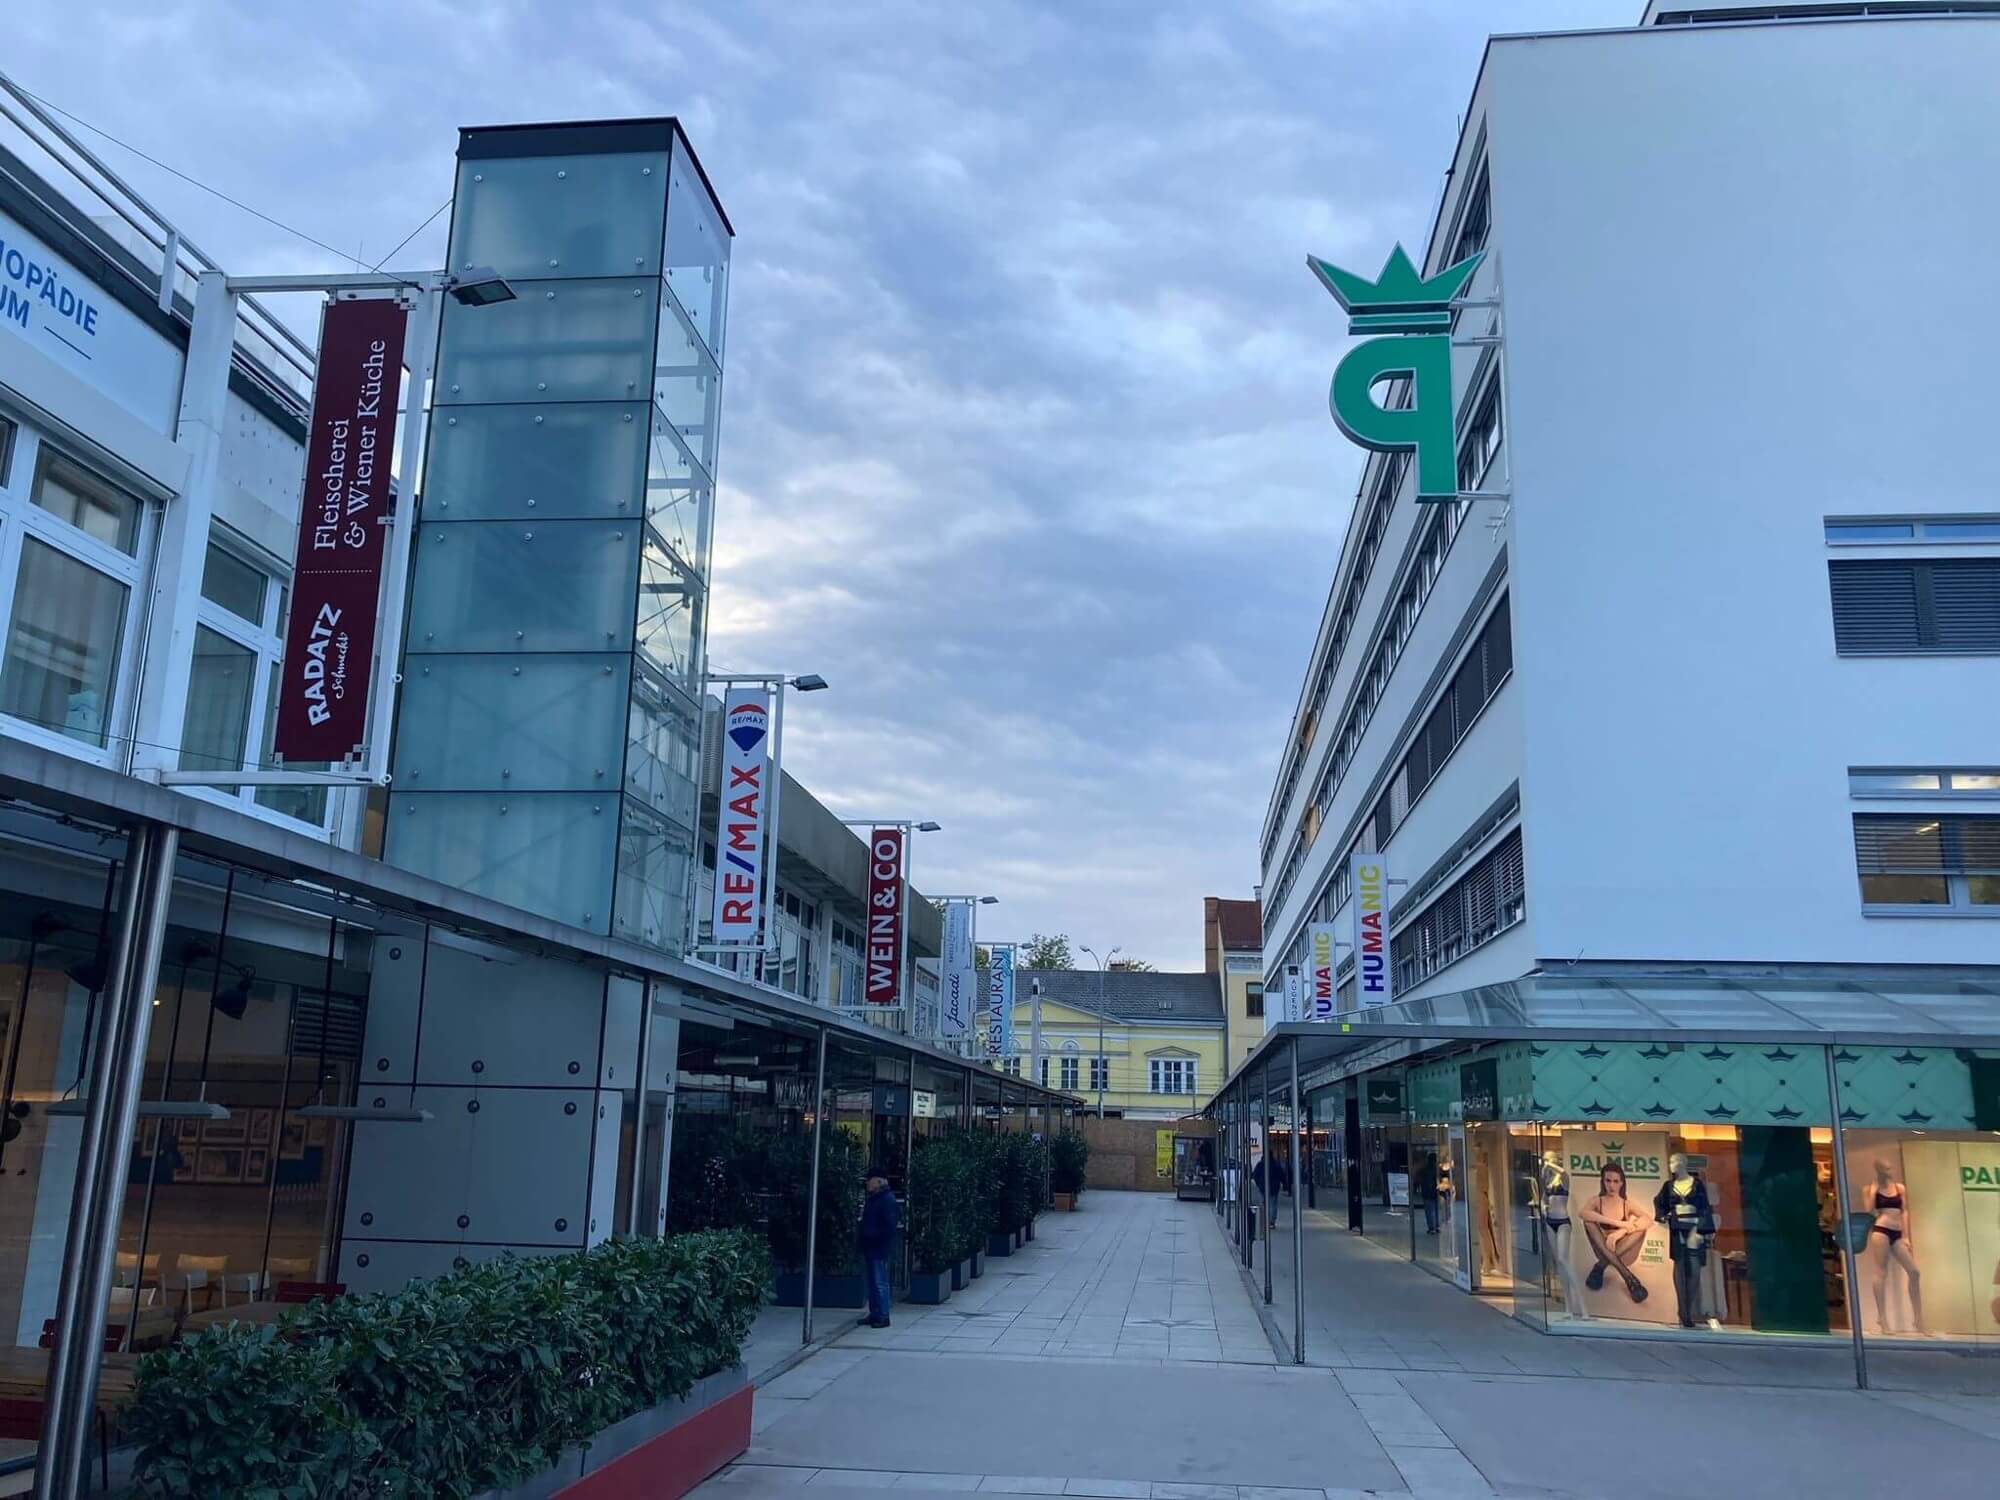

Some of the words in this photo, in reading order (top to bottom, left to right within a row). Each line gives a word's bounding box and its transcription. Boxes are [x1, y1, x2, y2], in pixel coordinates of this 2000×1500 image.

[0, 240, 98, 336] OPÄDIE
[357, 340, 386, 419] Küche
[314, 418, 350, 550] Fleischerei
[346, 425, 377, 515] Wiener
[343, 521, 366, 548] &
[303, 602, 342, 726] RADATZ
[731, 716, 765, 725] RE/MAX
[722, 764, 761, 924] RE/MAX
[873, 839, 897, 881] CO
[873, 886, 896, 909] &
[1359, 864, 1386, 992] HUMANIC
[869, 914, 895, 993] WEIN
[989, 948, 1004, 1057] RESTAURANT
